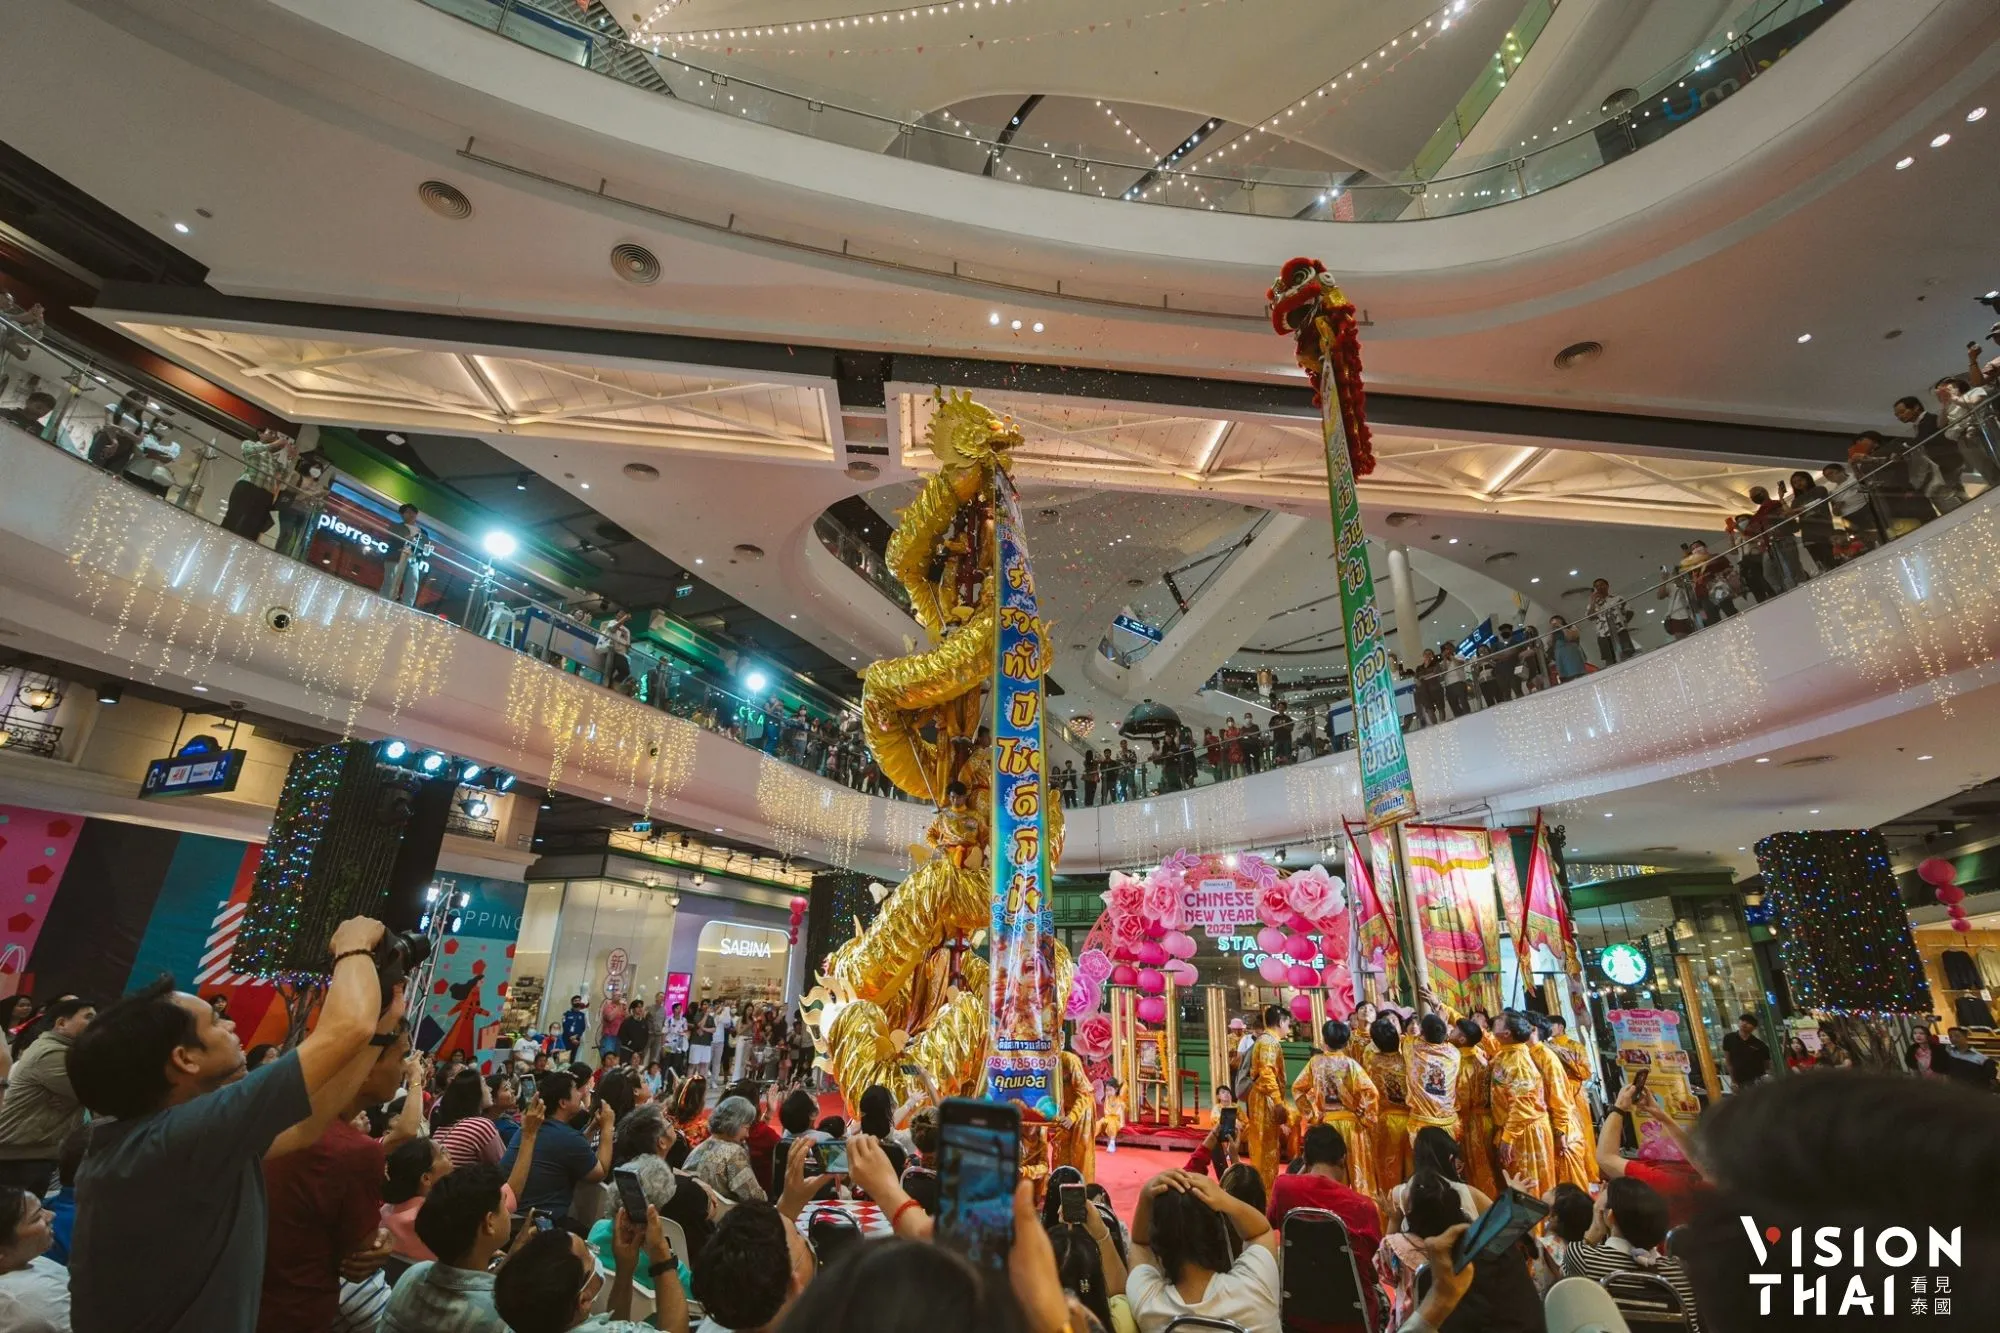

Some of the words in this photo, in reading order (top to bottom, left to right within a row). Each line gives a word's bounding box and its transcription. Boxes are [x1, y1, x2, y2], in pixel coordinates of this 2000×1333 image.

[317, 514, 430, 573] pierre-cn
[1184, 892, 1254, 908] CHINESE
[1185, 910, 1215, 923] NEW
[1219, 909, 1255, 922] YEAR
[1206, 924, 1233, 935] 2025
[720, 937, 771, 959] SABINA
[994, 1075, 1046, 1092] คุณมอส
